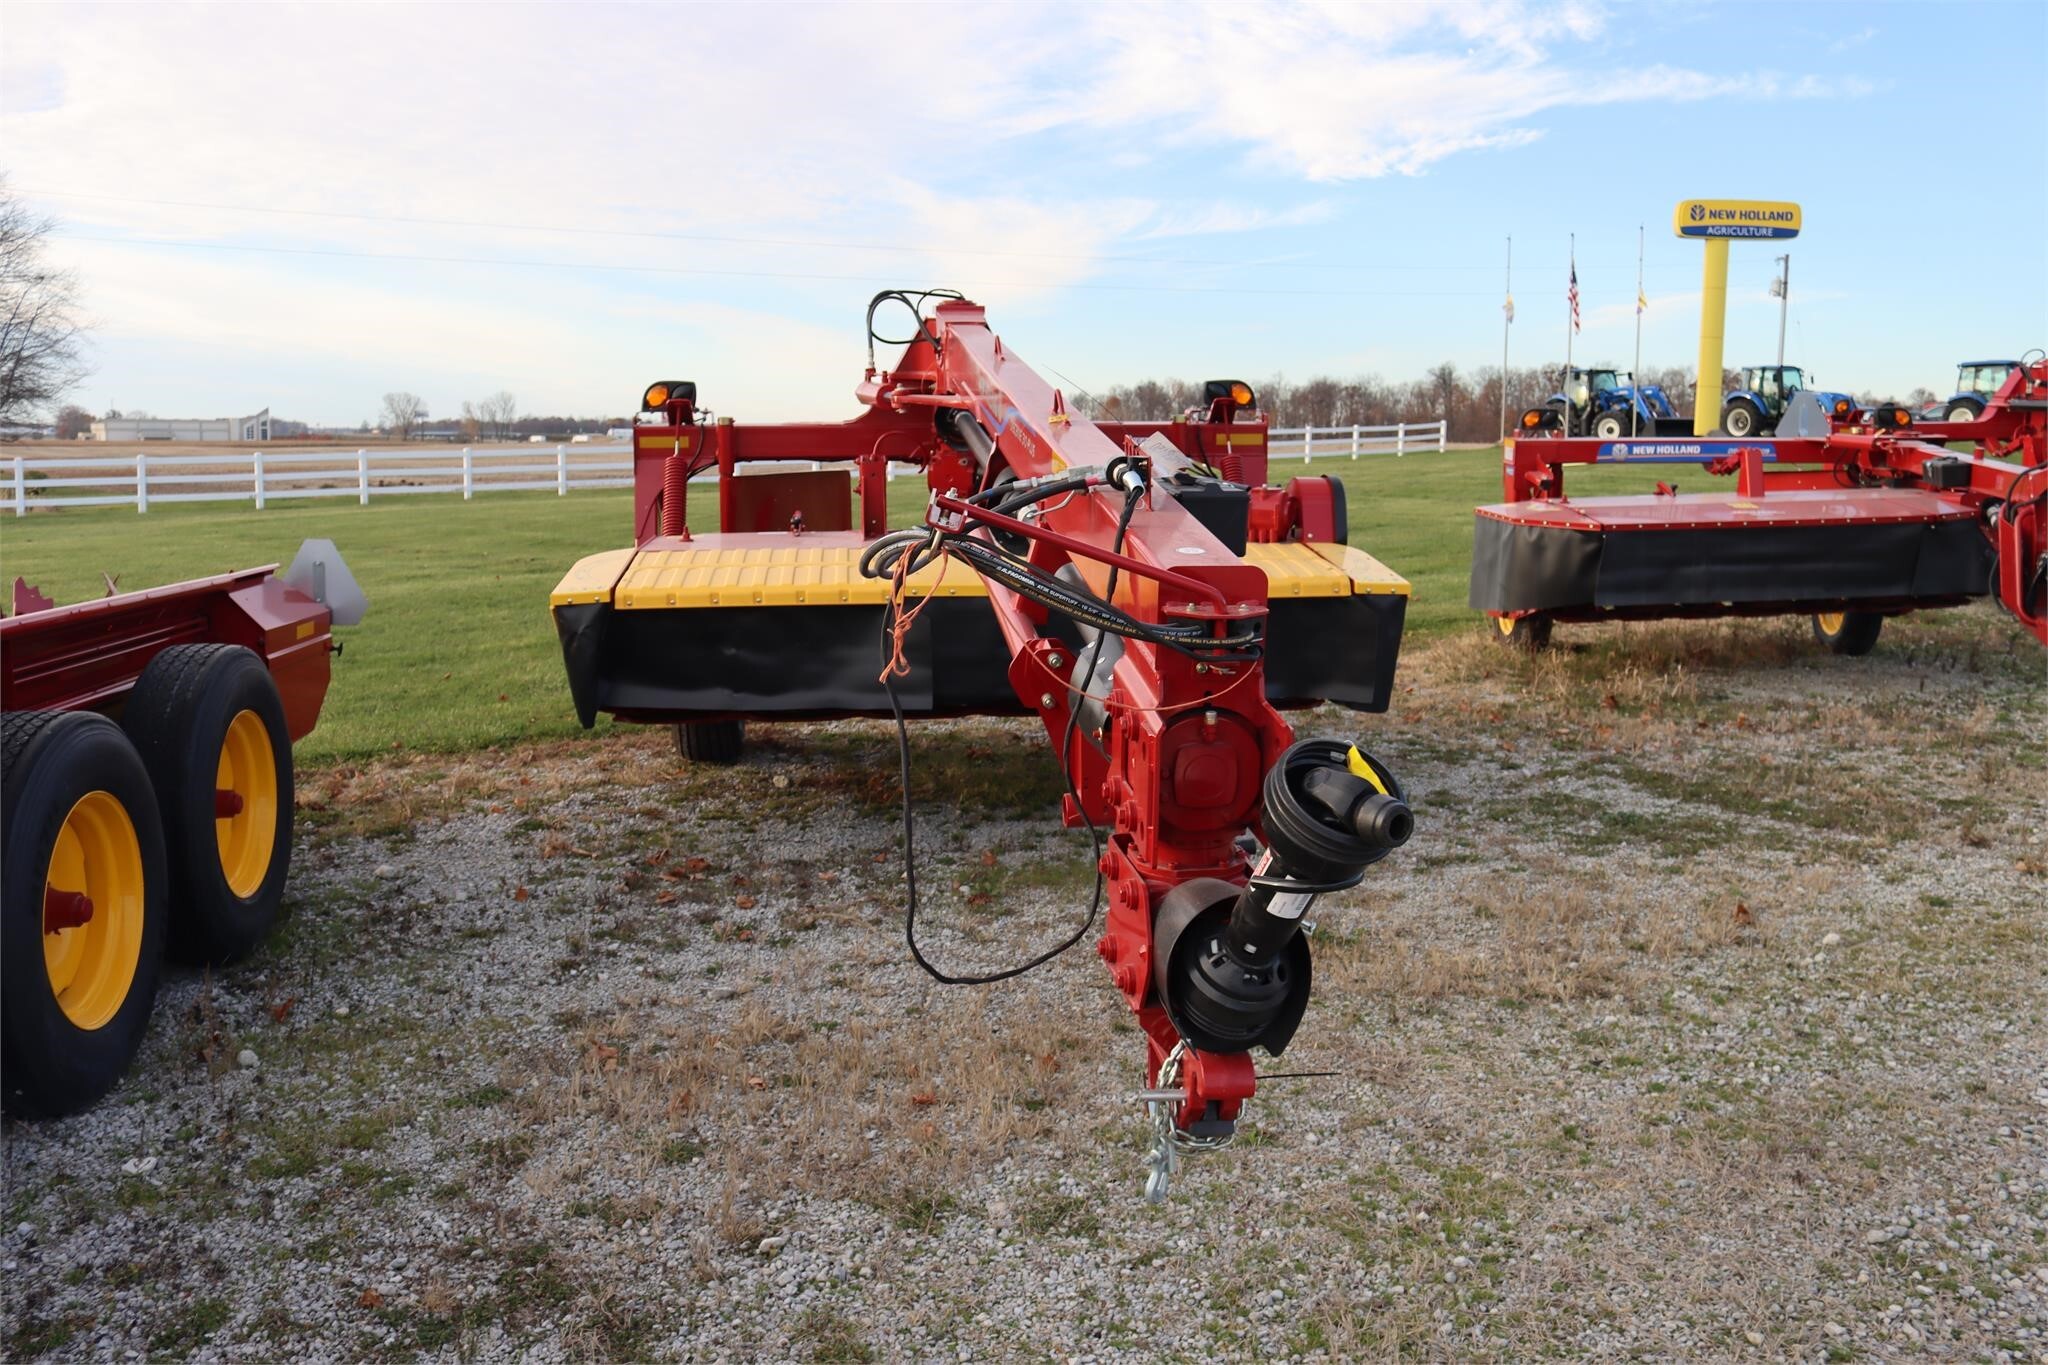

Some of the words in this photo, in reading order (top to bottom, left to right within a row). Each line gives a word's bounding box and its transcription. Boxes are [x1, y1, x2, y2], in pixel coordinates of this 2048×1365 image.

[1709, 209, 1736, 220] NEW
[1739, 210, 1793, 221] HOLLAND
[1706, 226, 1774, 237] AGRICULTURE
[1632, 445, 1654, 455] NEW
[1656, 444, 1700, 455] HOLLAND
